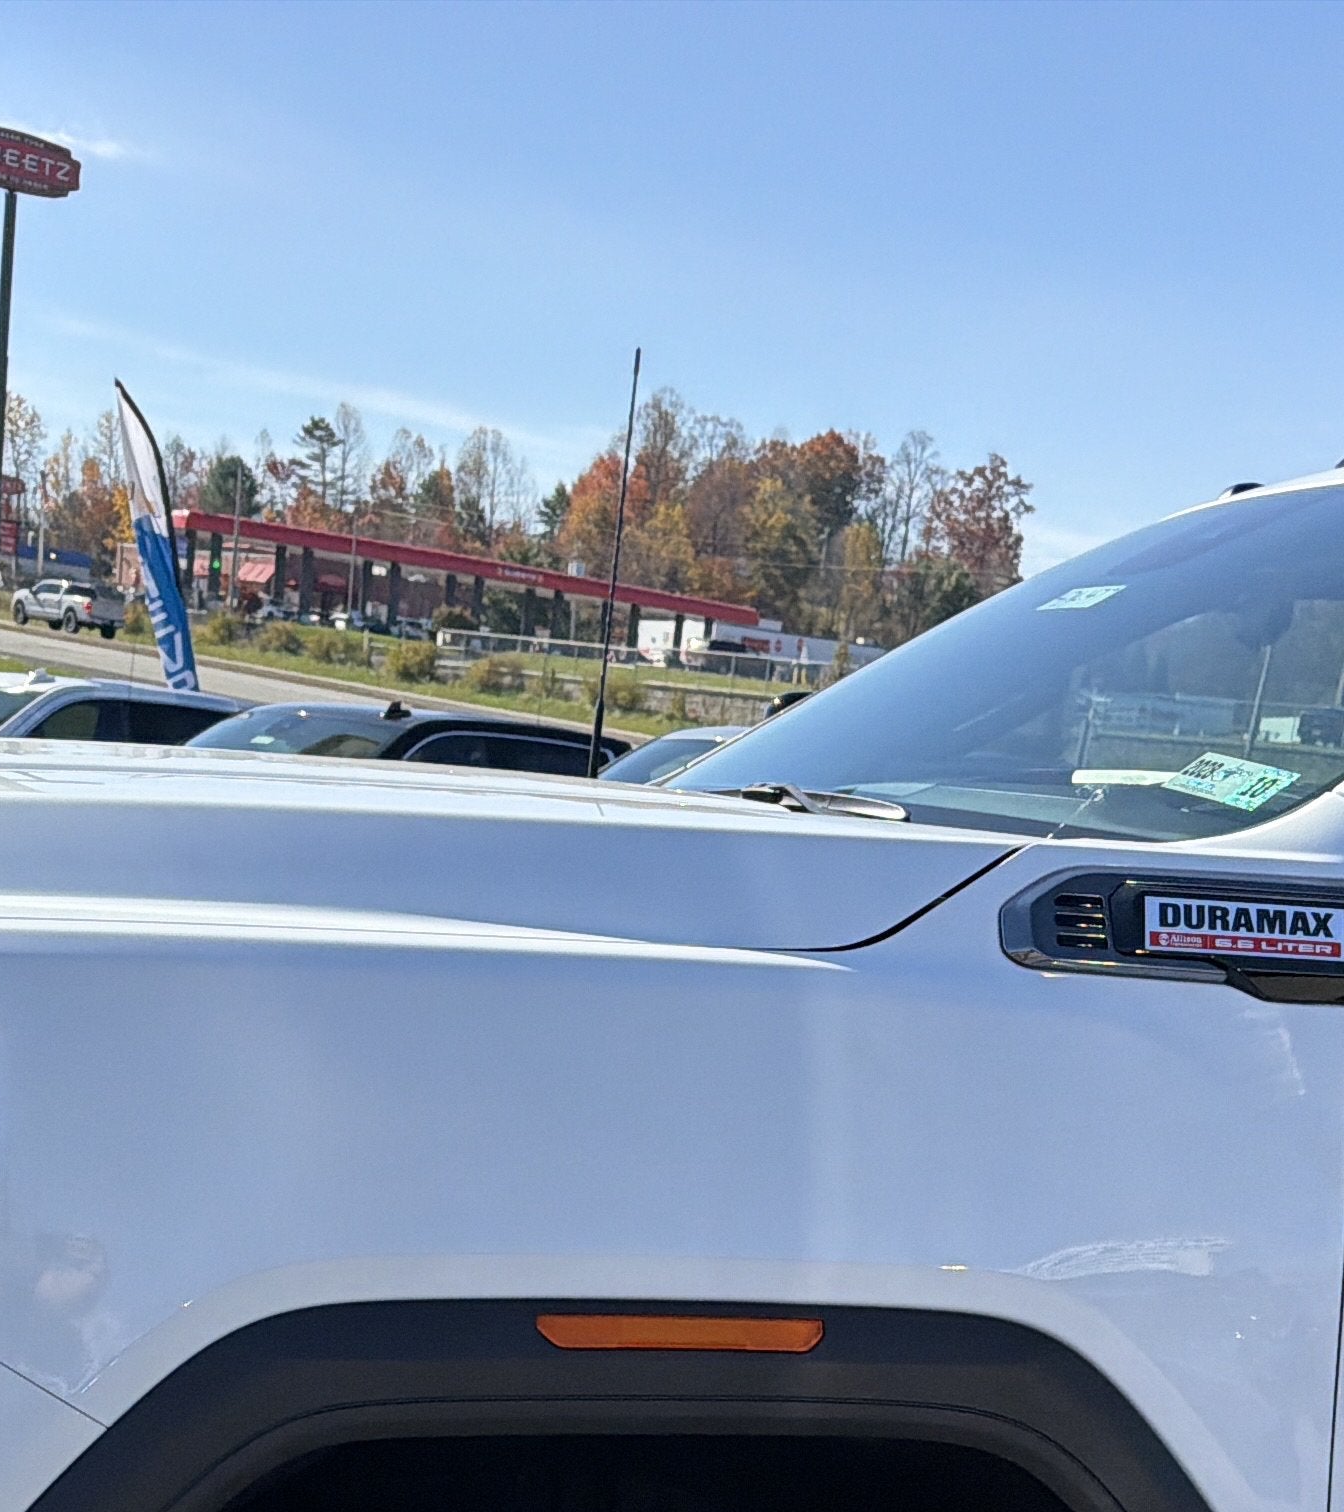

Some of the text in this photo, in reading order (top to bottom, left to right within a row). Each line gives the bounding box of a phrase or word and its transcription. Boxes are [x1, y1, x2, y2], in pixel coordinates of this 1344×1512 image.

[1158, 901, 1334, 939] DURAMAX
[1170, 933, 1333, 955] Allison 6.6 LITER
